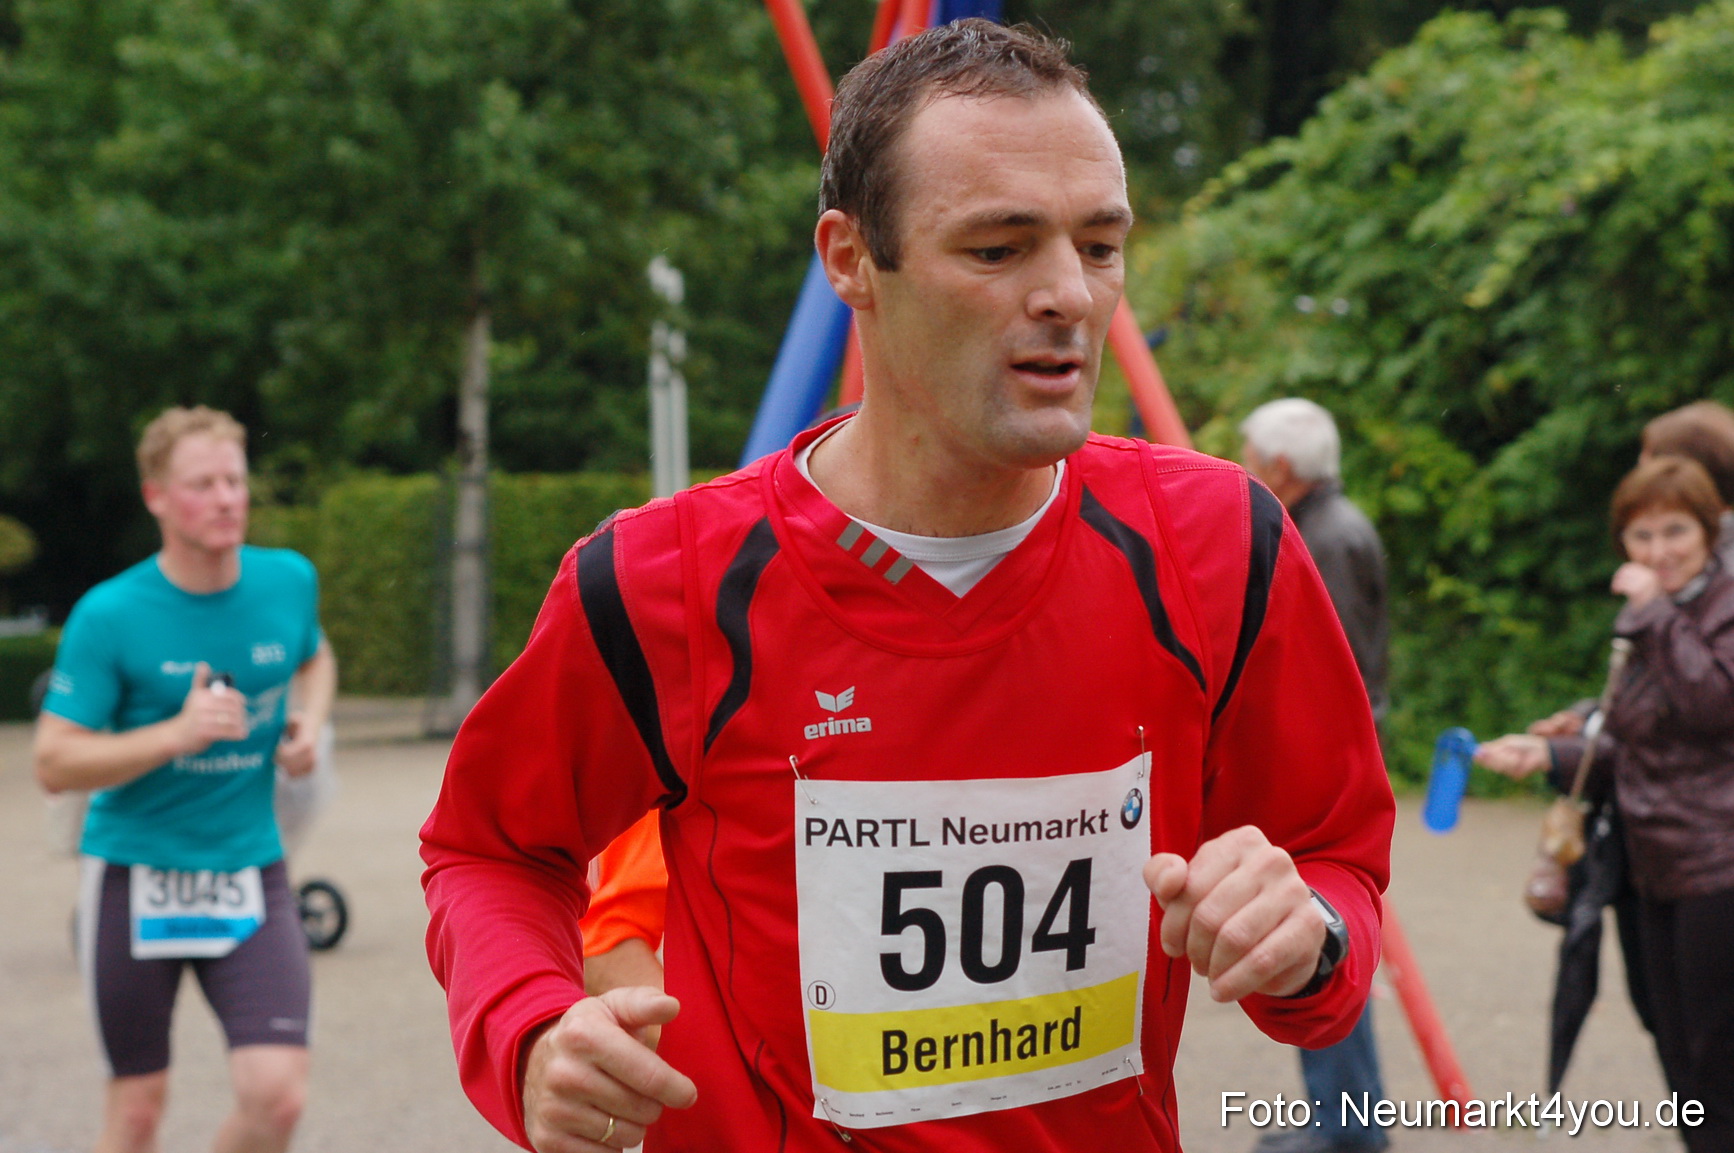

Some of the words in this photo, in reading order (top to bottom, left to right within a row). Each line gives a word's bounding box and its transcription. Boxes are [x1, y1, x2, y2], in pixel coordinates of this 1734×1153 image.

[804, 716, 872, 740] erima
[805, 817, 930, 847] PARTL
[942, 808, 1109, 846] Neumarkt
[880, 857, 1096, 992] 504
[815, 985, 828, 1006] D
[883, 1006, 1081, 1076] Bernhard
